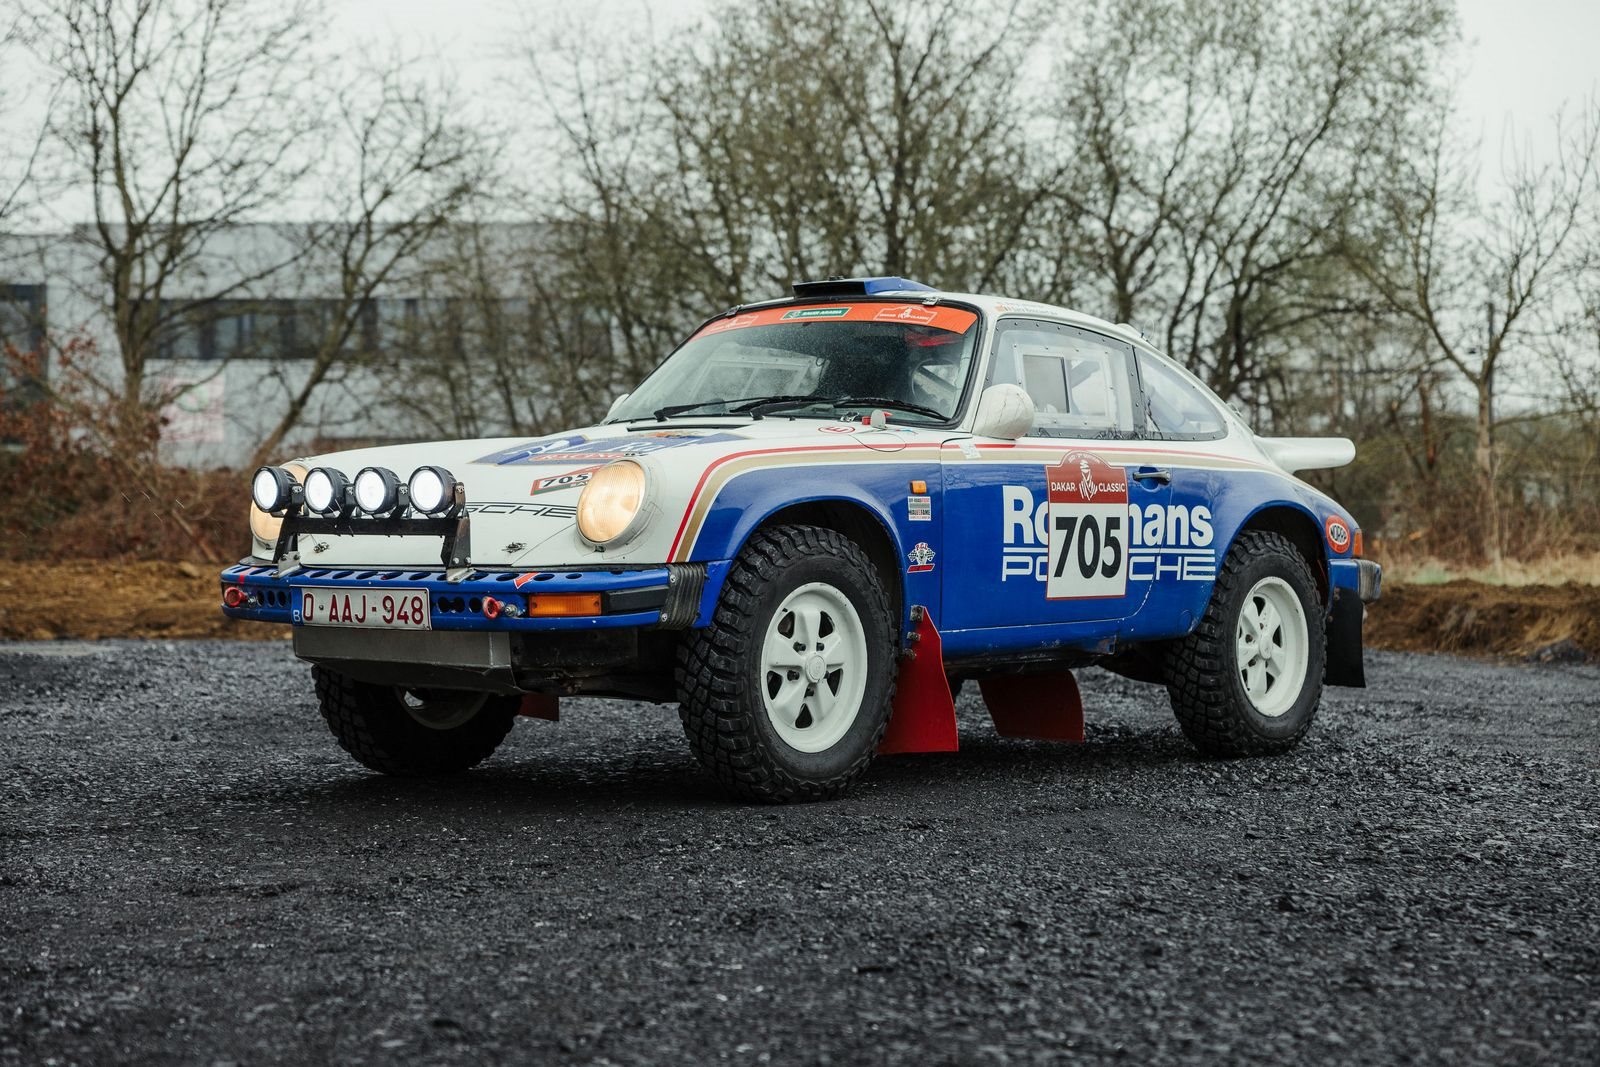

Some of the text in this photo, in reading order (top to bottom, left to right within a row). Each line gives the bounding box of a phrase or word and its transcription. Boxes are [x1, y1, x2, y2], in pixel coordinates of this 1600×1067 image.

[543, 472, 589, 488] 705
[1051, 482, 1126, 493] DAKAR CLASSIC
[1002, 485, 1214, 547] Roans
[1053, 514, 1121, 579] 705
[1002, 556, 1216, 582] PCHE
[292, 609, 301, 622] B
